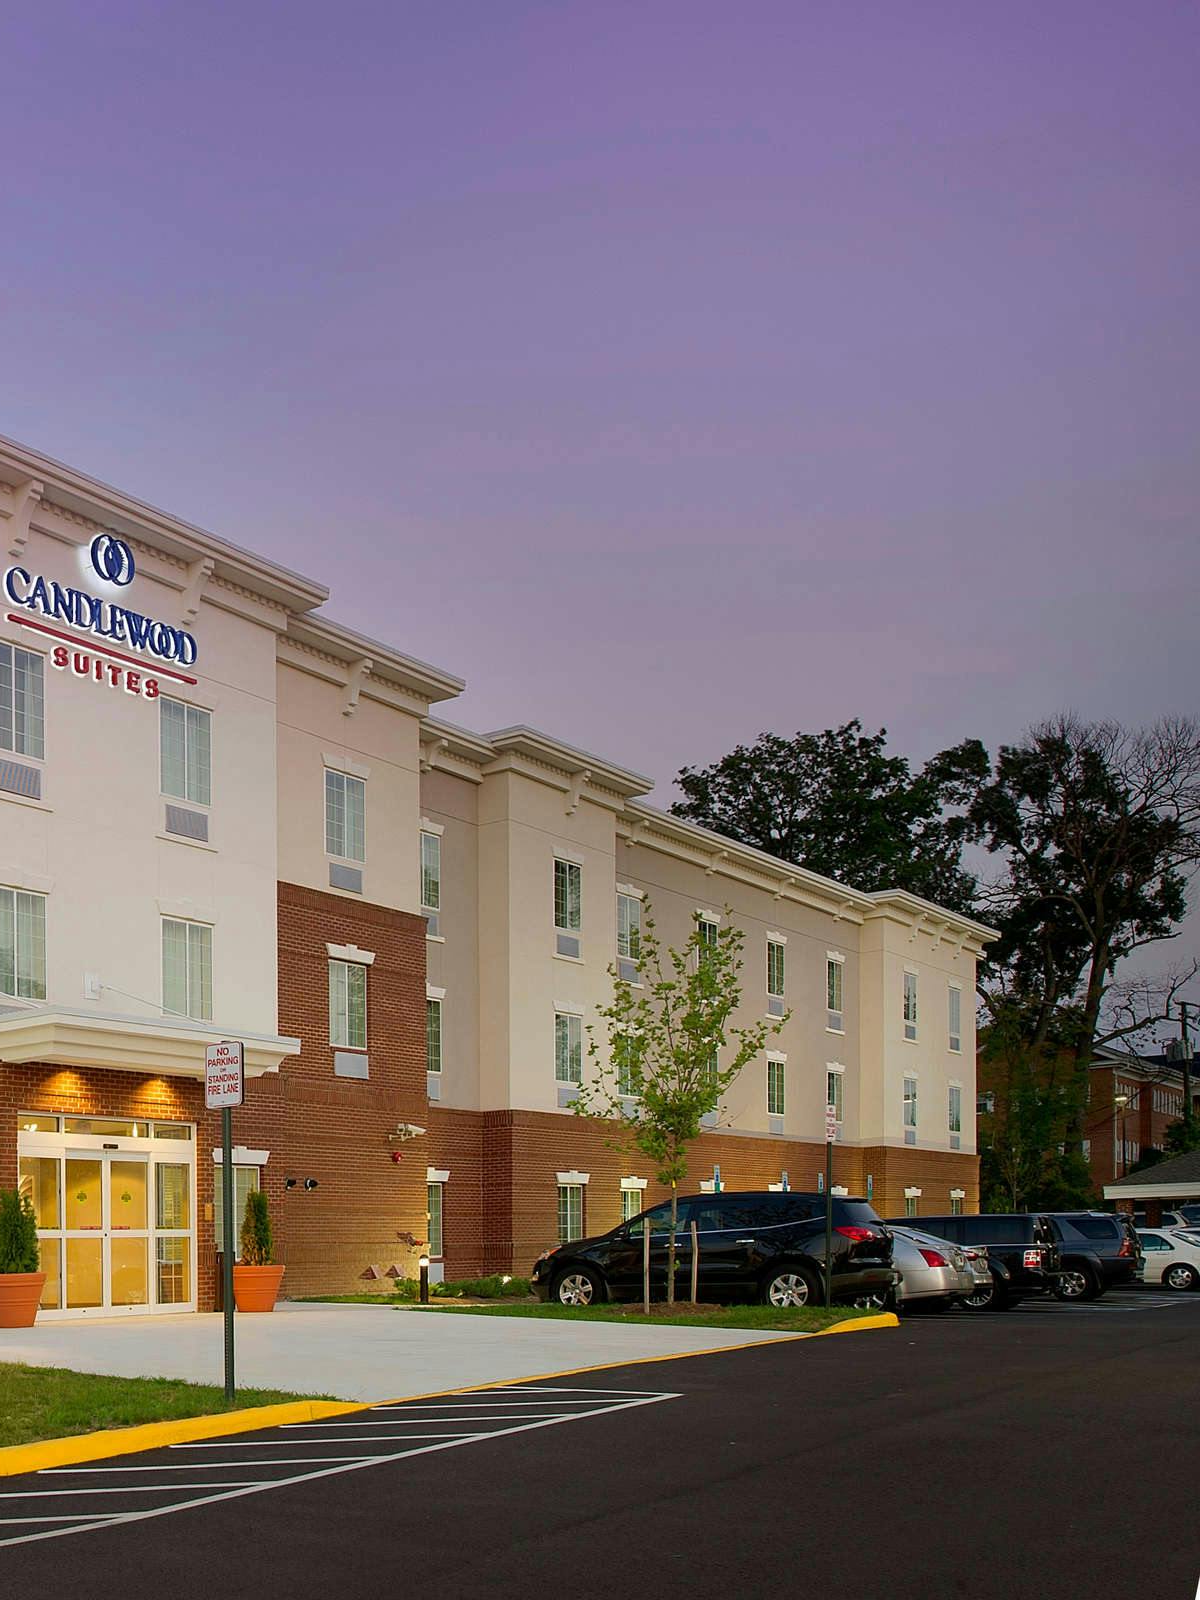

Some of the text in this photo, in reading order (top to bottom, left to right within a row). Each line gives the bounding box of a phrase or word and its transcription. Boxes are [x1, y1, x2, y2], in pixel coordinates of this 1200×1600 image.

[5, 566, 198, 665] CANDLEWOOD
[53, 646, 160, 698] SUITES
[216, 1047, 229, 1056] NO
[207, 1056, 239, 1067] PARKING
[208, 1073, 239, 1084] STANDING
[208, 1083, 239, 1095] FIRE LANE
